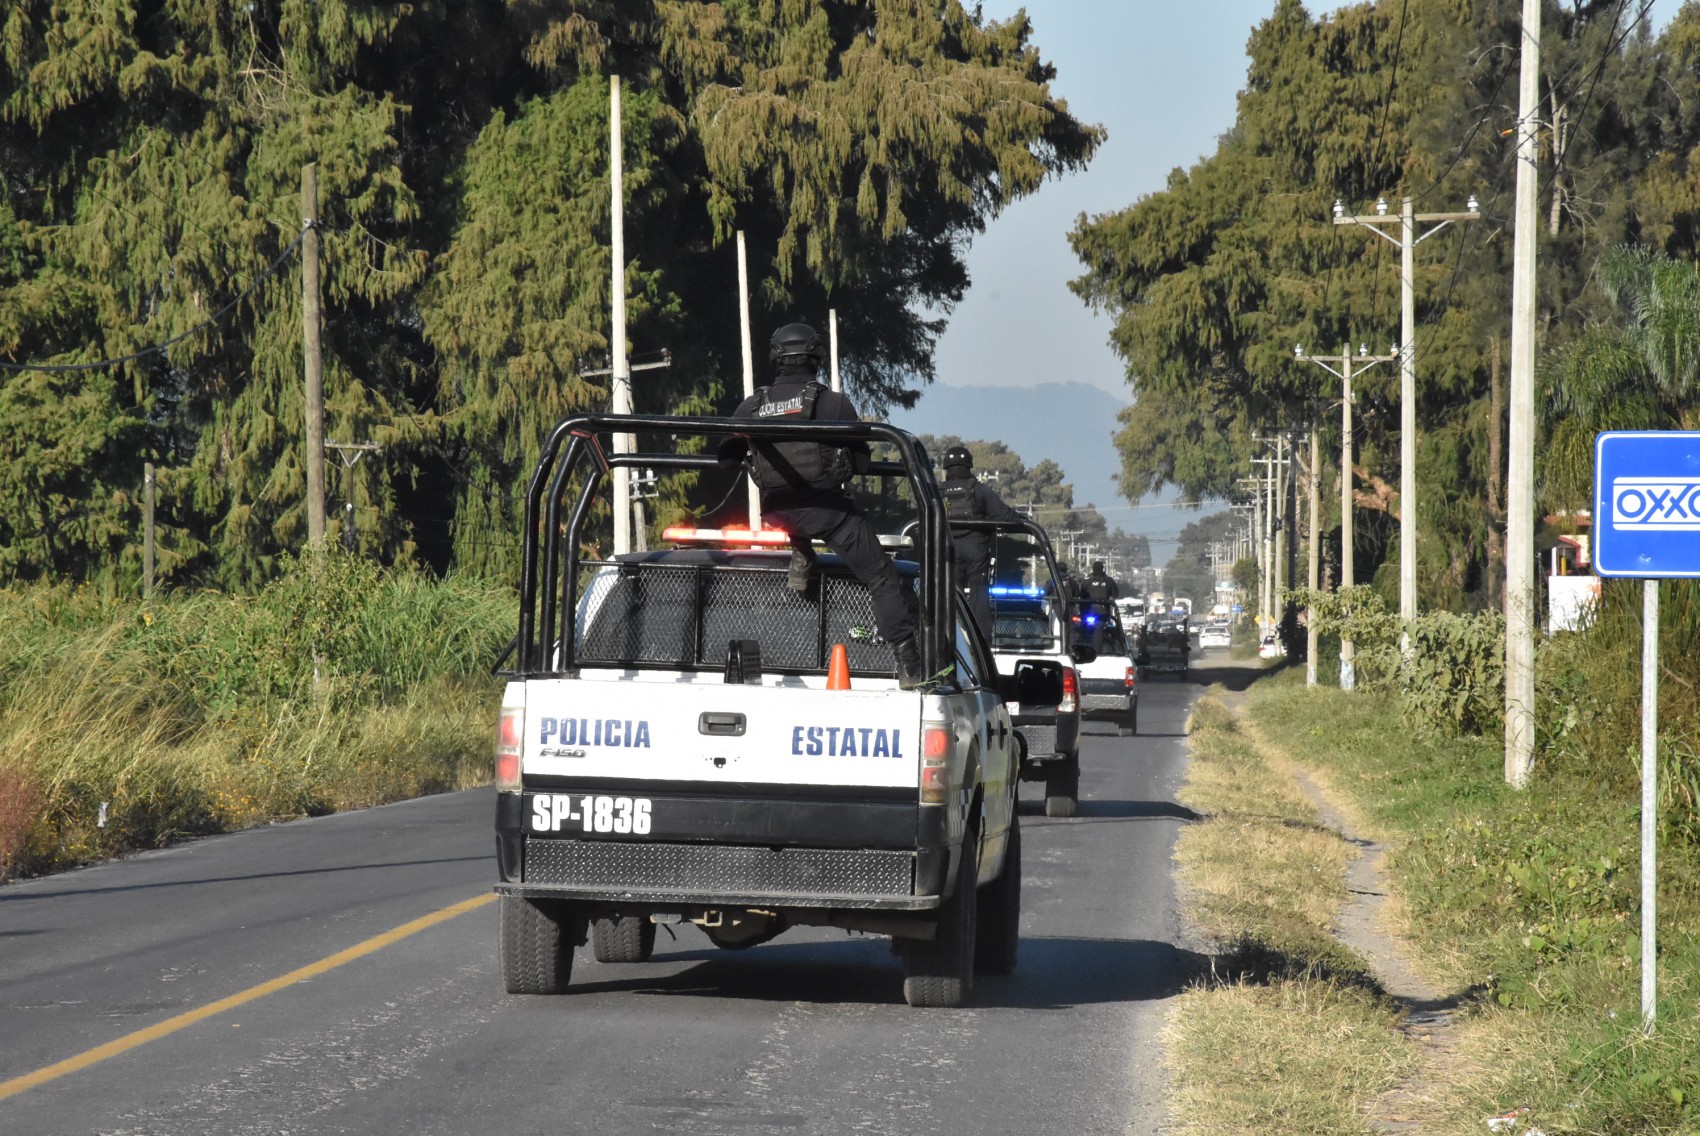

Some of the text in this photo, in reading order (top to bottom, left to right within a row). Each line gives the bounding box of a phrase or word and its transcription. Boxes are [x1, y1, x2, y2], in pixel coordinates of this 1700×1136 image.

[777, 396, 803, 412] ESTATAL
[540, 717, 903, 758] POLICIA ESTATAL
[532, 794, 652, 834] SP-1836
